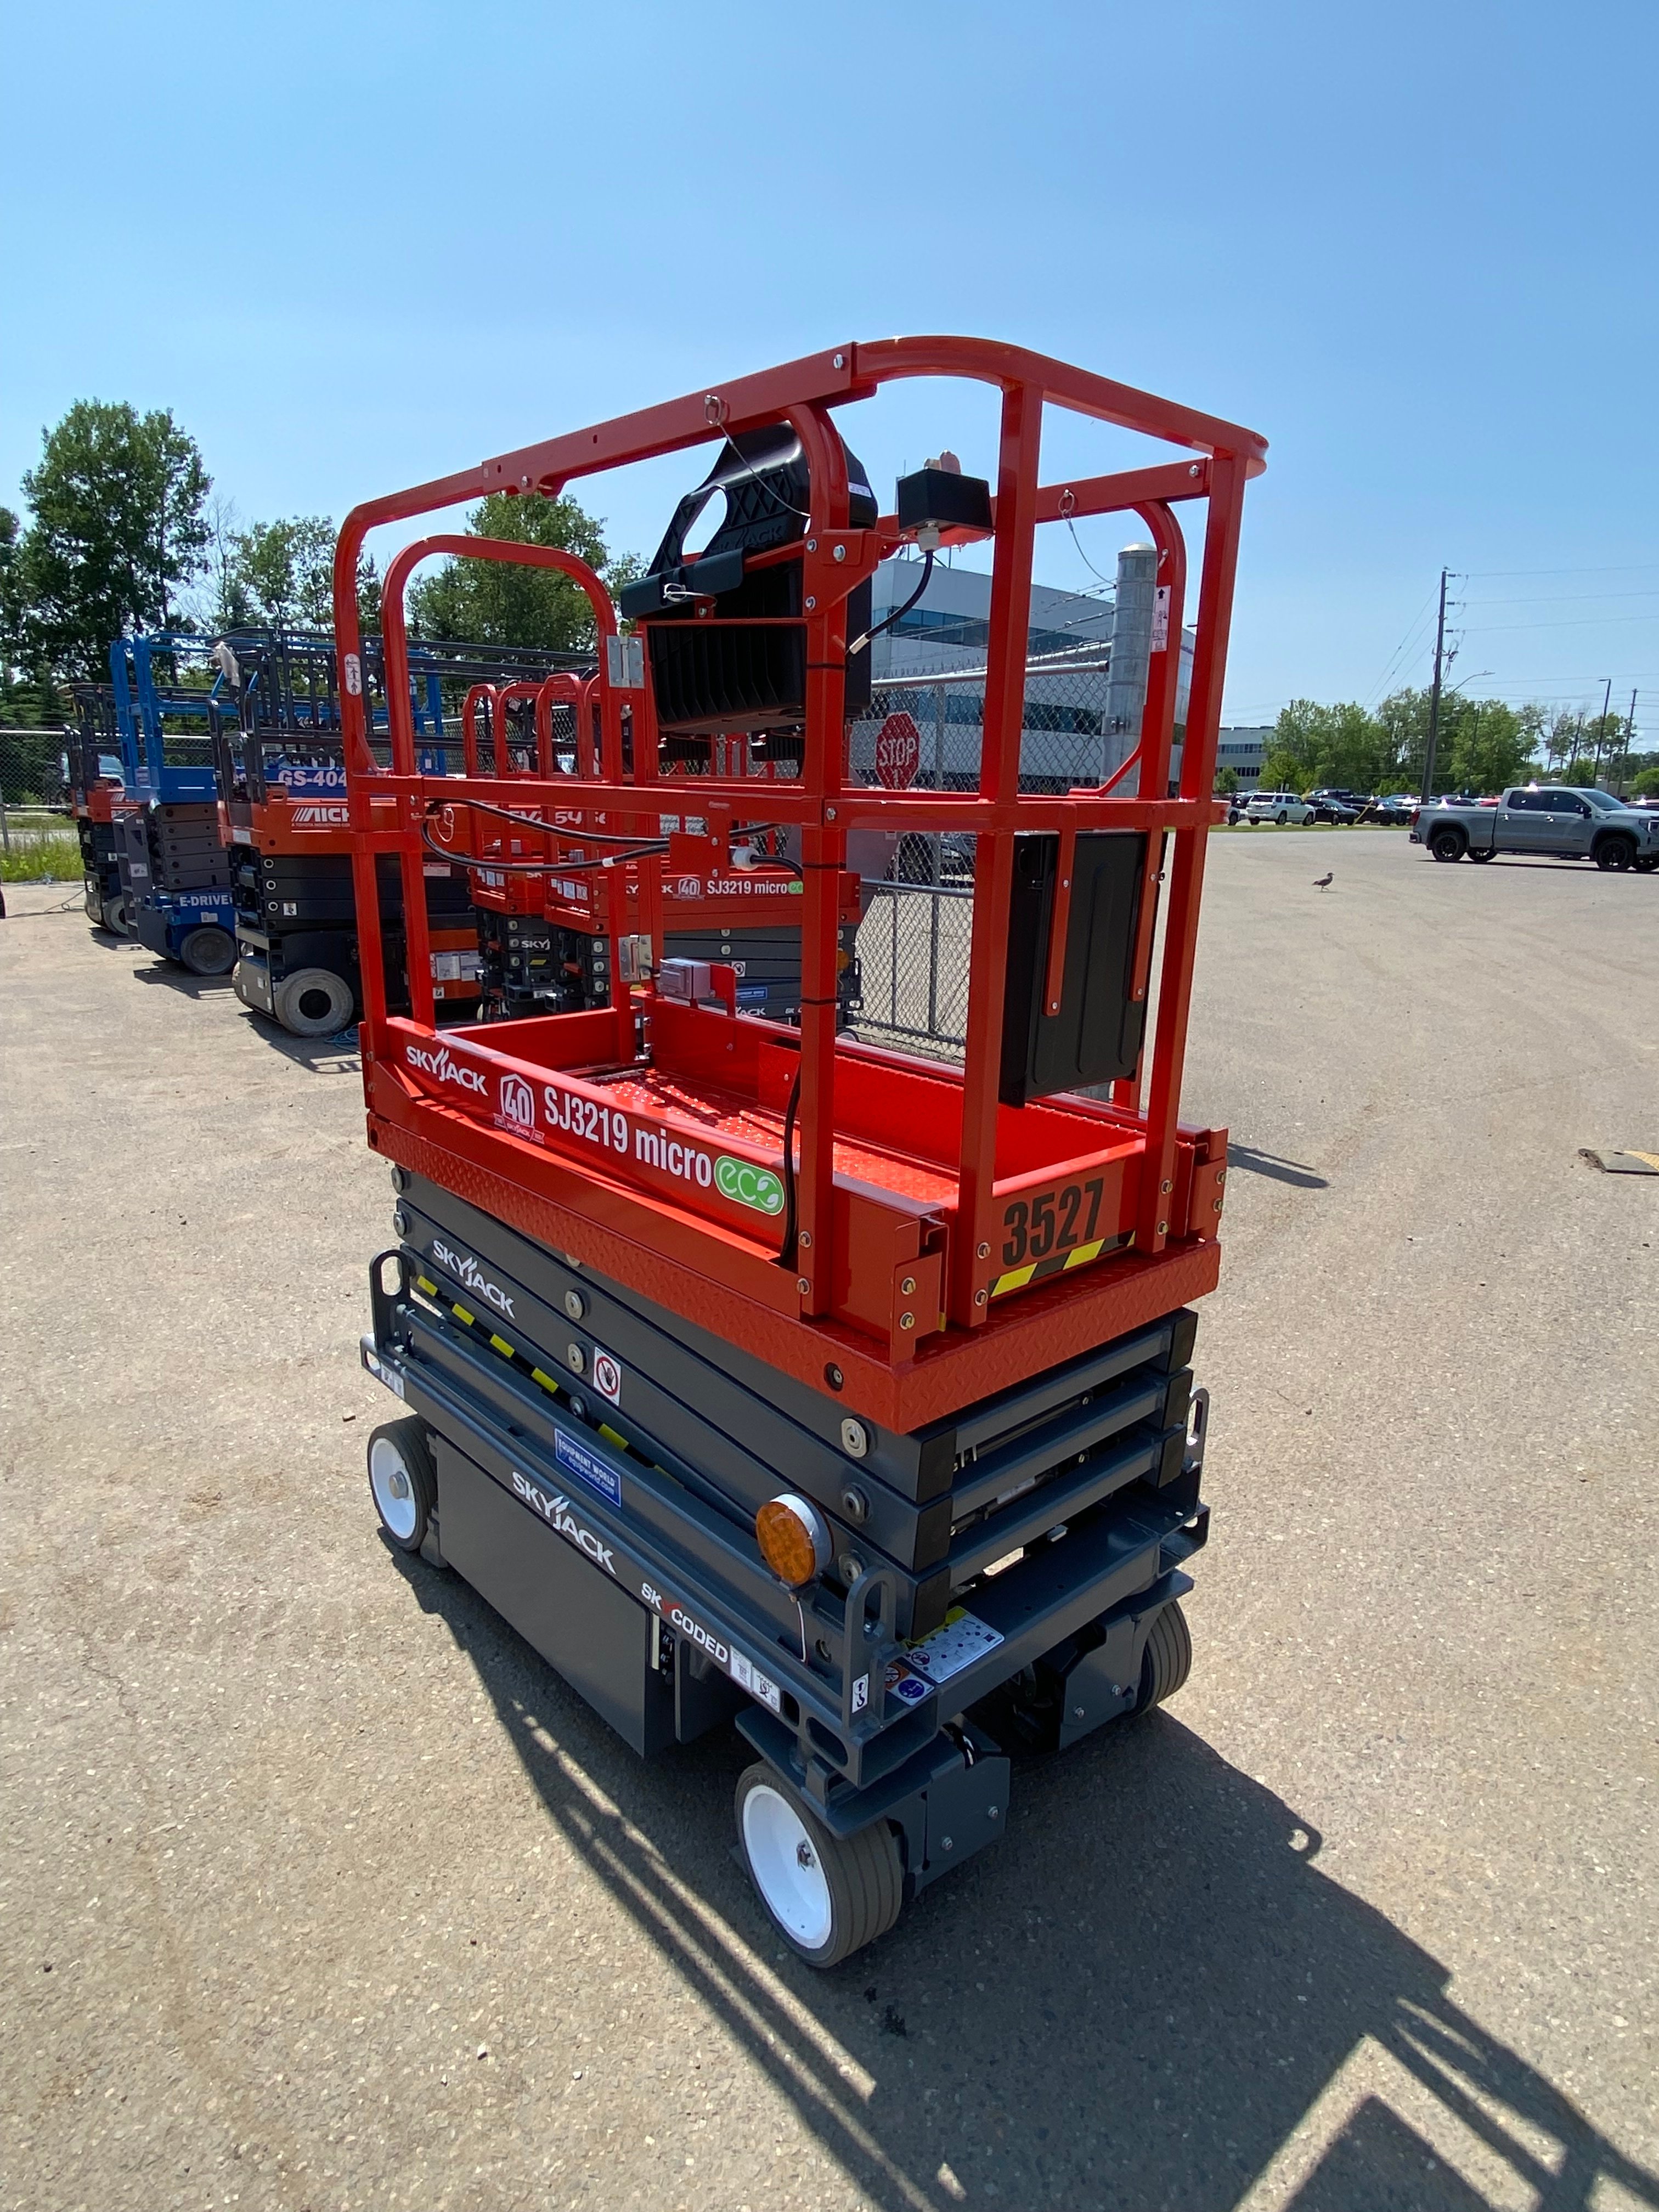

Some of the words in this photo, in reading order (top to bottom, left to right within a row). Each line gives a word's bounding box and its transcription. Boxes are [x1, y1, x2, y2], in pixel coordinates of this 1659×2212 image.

[278, 770, 347, 787] GS-404
[878, 737, 916, 767] STOP
[707, 880, 752, 894] SJ3219
[754, 880, 787, 894] micro
[521, 939, 550, 950] SKYJ
[406, 1046, 489, 1097] SKYJACK
[505, 1081, 531, 1126] 40
[544, 1086, 629, 1153] SJ3219
[635, 1127, 712, 1188] micro
[719, 1161, 780, 1209] eco
[1002, 1177, 1104, 1267] 3527
[433, 1240, 516, 1319] SKYJACK
[558, 1438, 591, 1469] EQUIPMENT
[592, 1464, 615, 1487] WORLD
[512, 1471, 617, 1575] SKYJACK
[641, 1582, 729, 1663] SKYCODED
